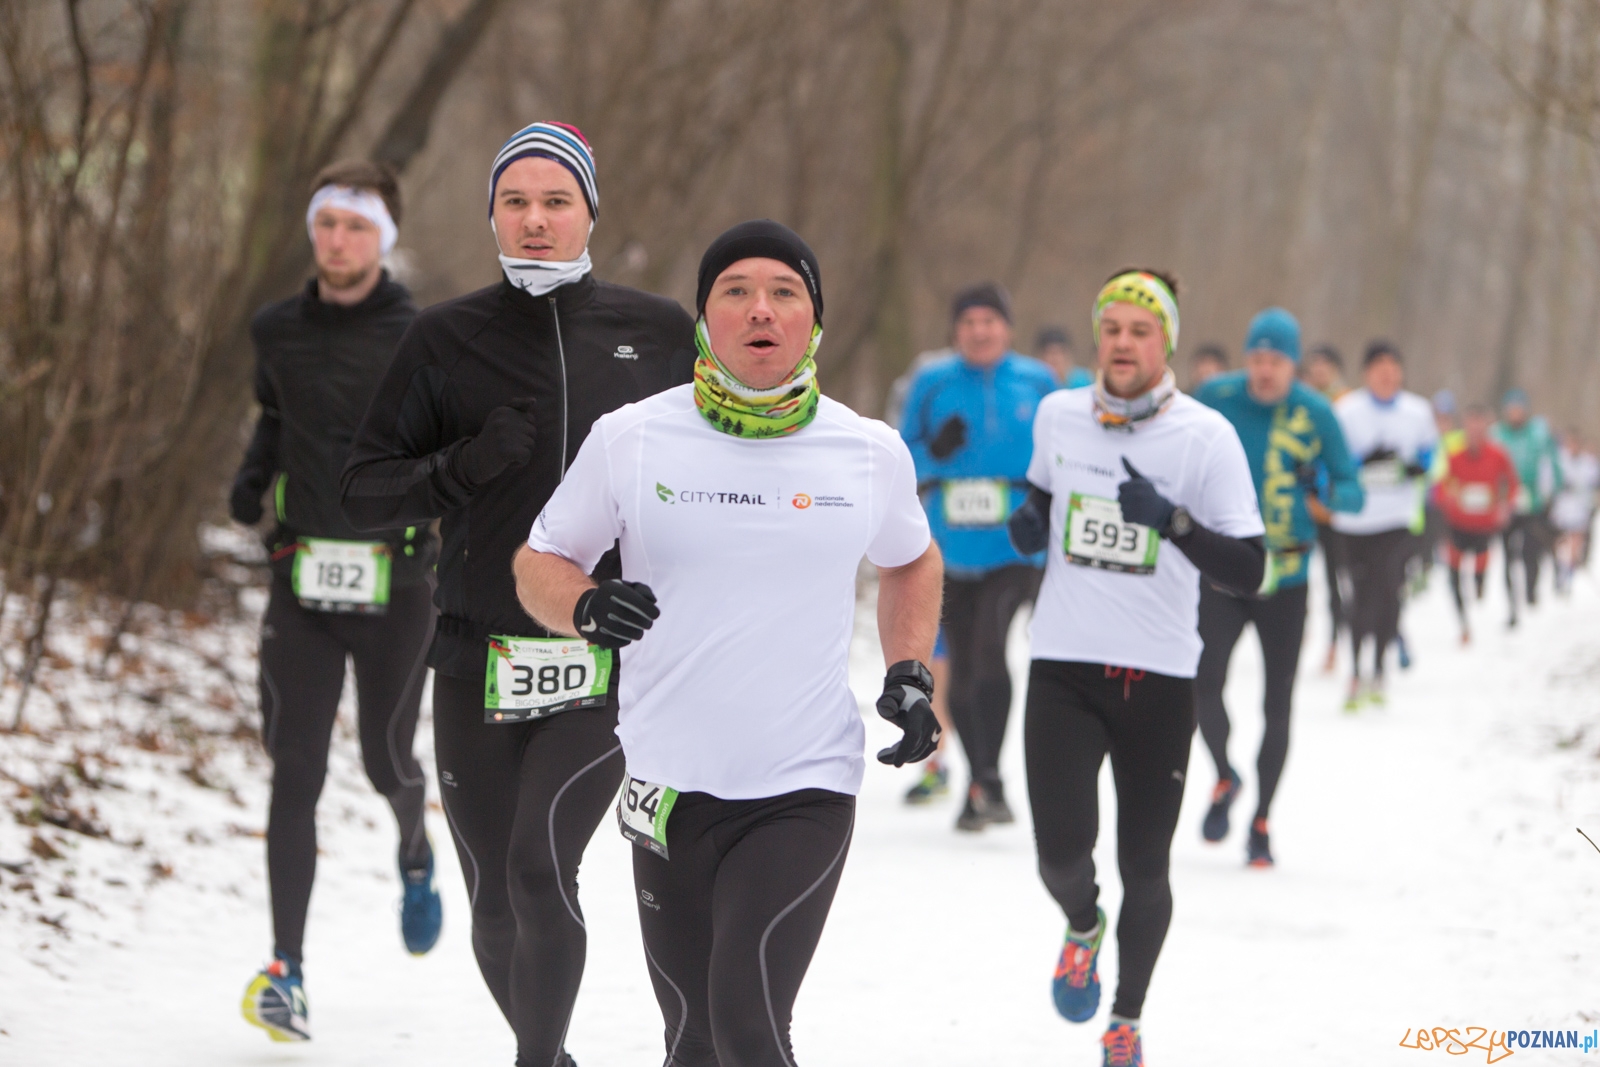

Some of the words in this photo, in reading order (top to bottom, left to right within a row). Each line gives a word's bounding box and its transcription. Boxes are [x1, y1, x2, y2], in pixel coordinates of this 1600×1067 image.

[1081, 518, 1138, 552] 593
[317, 561, 364, 590] 182
[511, 664, 587, 696] 380
